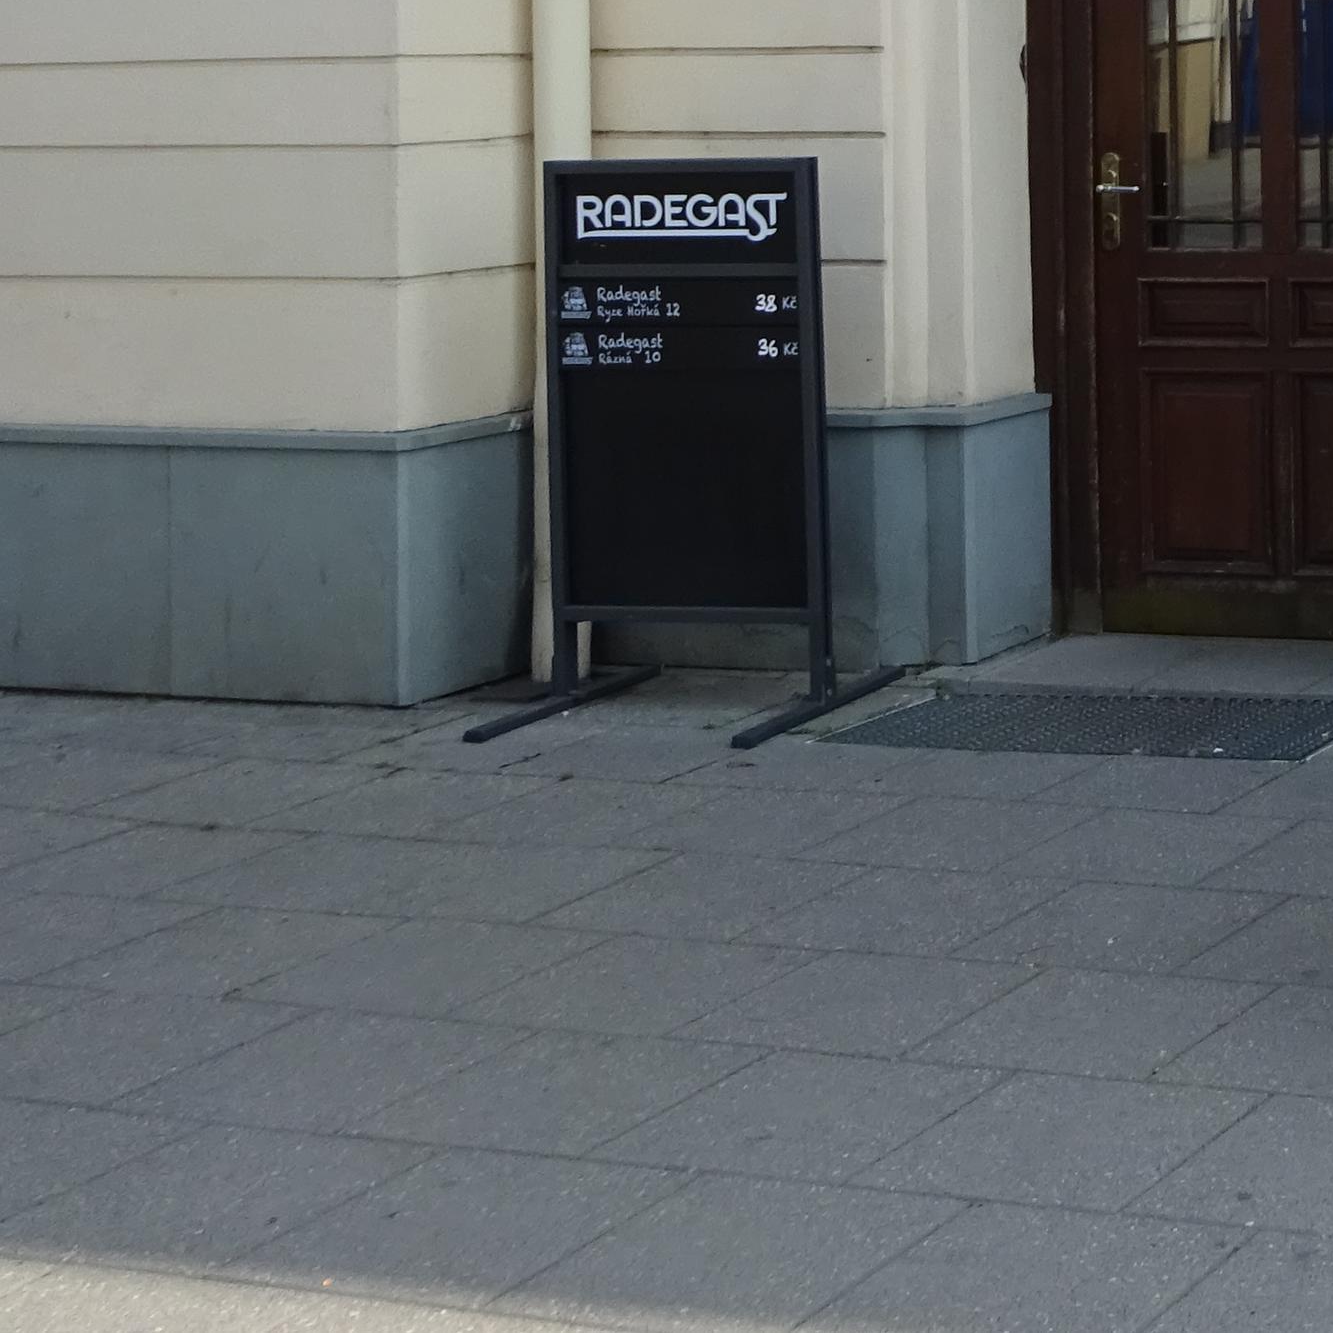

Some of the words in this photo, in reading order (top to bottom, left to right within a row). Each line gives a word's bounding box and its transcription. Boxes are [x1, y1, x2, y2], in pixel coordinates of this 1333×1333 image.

[576, 192, 787, 241] RADEGAST
[597, 285, 661, 307] Radegast
[756, 294, 777, 313] 38
[782, 296, 797, 309] Kč
[597, 305, 623, 323] Ryze
[666, 303, 680, 317] 12
[598, 332, 663, 354] Radegast
[758, 338, 778, 357] 36
[784, 342, 798, 355] Kč
[599, 351, 632, 365] Rázná
[645, 350, 661, 364] 10
